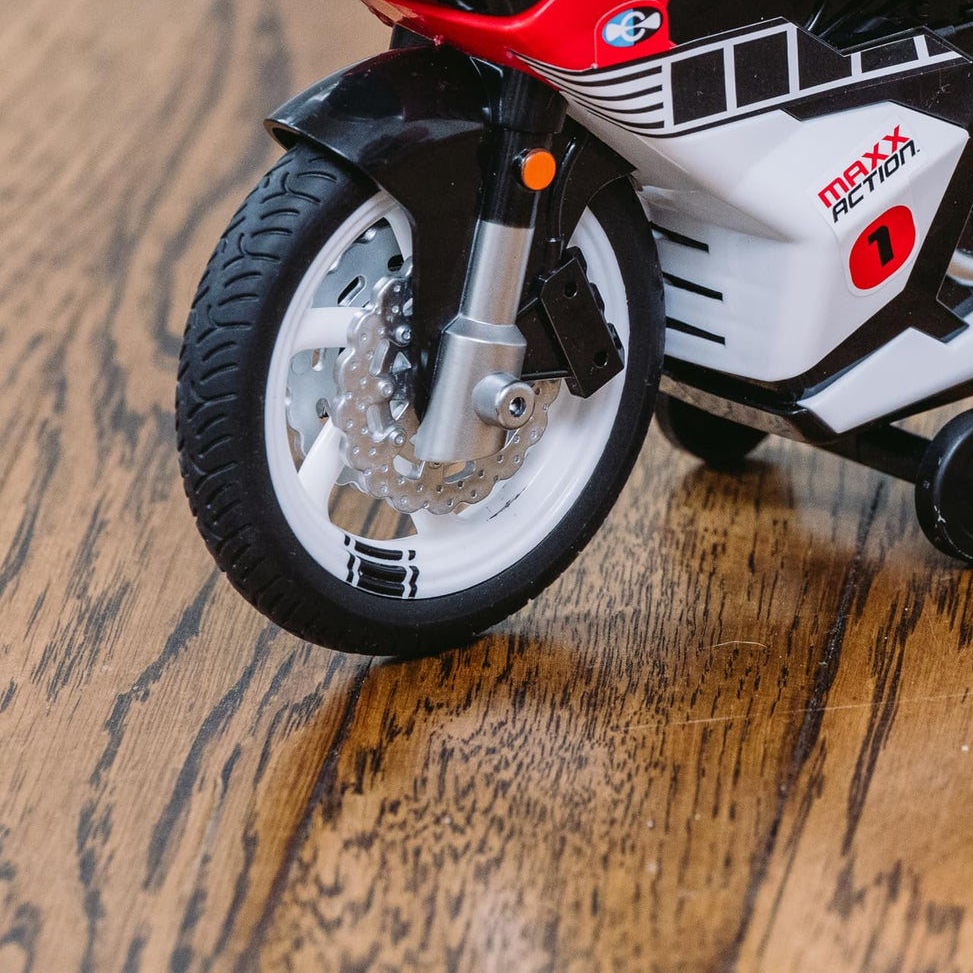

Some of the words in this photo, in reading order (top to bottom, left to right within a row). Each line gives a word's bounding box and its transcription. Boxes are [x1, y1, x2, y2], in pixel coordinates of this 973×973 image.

[817, 124, 911, 209] MAXX
[832, 139, 916, 223] ACTION
[867, 225, 895, 268] 1
